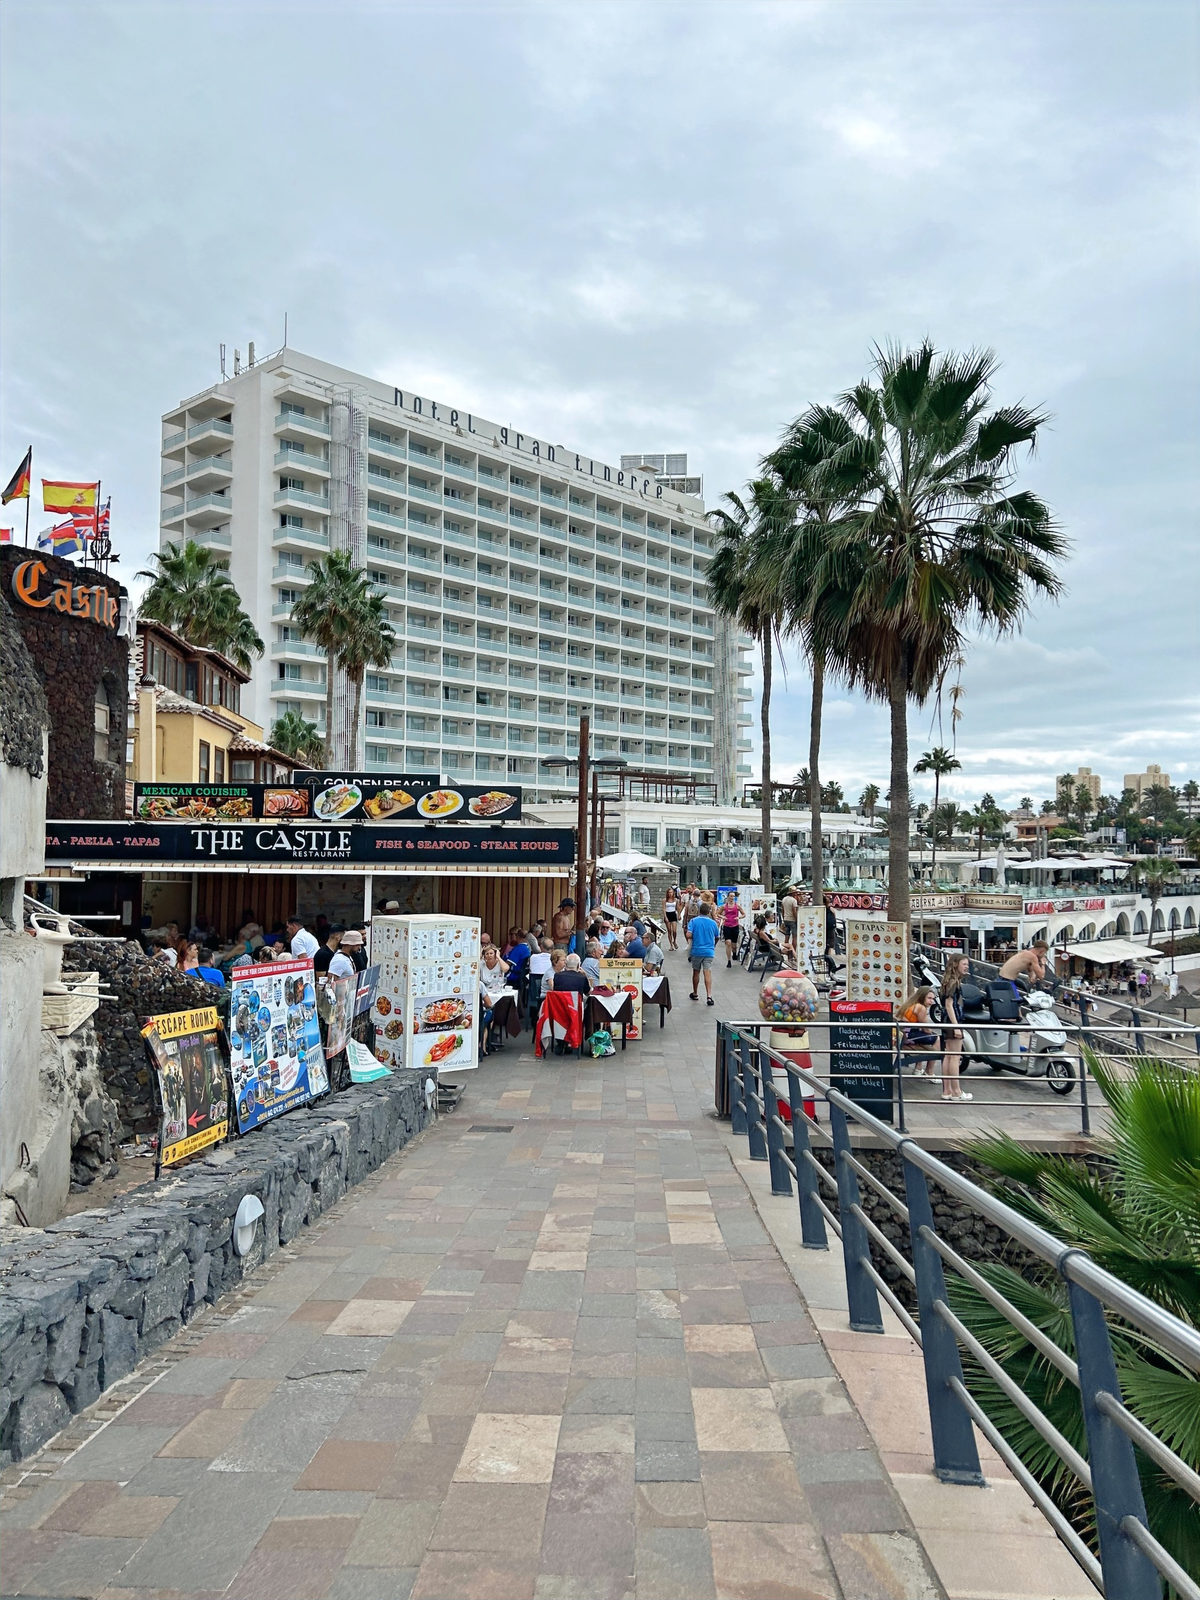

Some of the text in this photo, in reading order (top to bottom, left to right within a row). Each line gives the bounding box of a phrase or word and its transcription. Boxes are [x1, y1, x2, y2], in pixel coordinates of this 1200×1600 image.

[393, 387, 663, 500] hotel gran tinerfe
[142, 786, 248, 797] MEXICAN COUISINE
[70, 837, 114, 847] PAELLA
[124, 837, 161, 847] TAPAS
[191, 829, 352, 856] THE CASTLE
[375, 840, 403, 849] FISH
[405, 840, 415, 849] &
[417, 840, 471, 850] SEAFOOD
[480, 841, 518, 850] STEAK
[520, 841, 560, 851] HOUSE
[292, 850, 351, 858] RESTAURANT
[861, 923, 885, 932] TAPAS
[614, 960, 635, 968] Tropical
[156, 1010, 214, 1036] ESCAPE ROOMS
